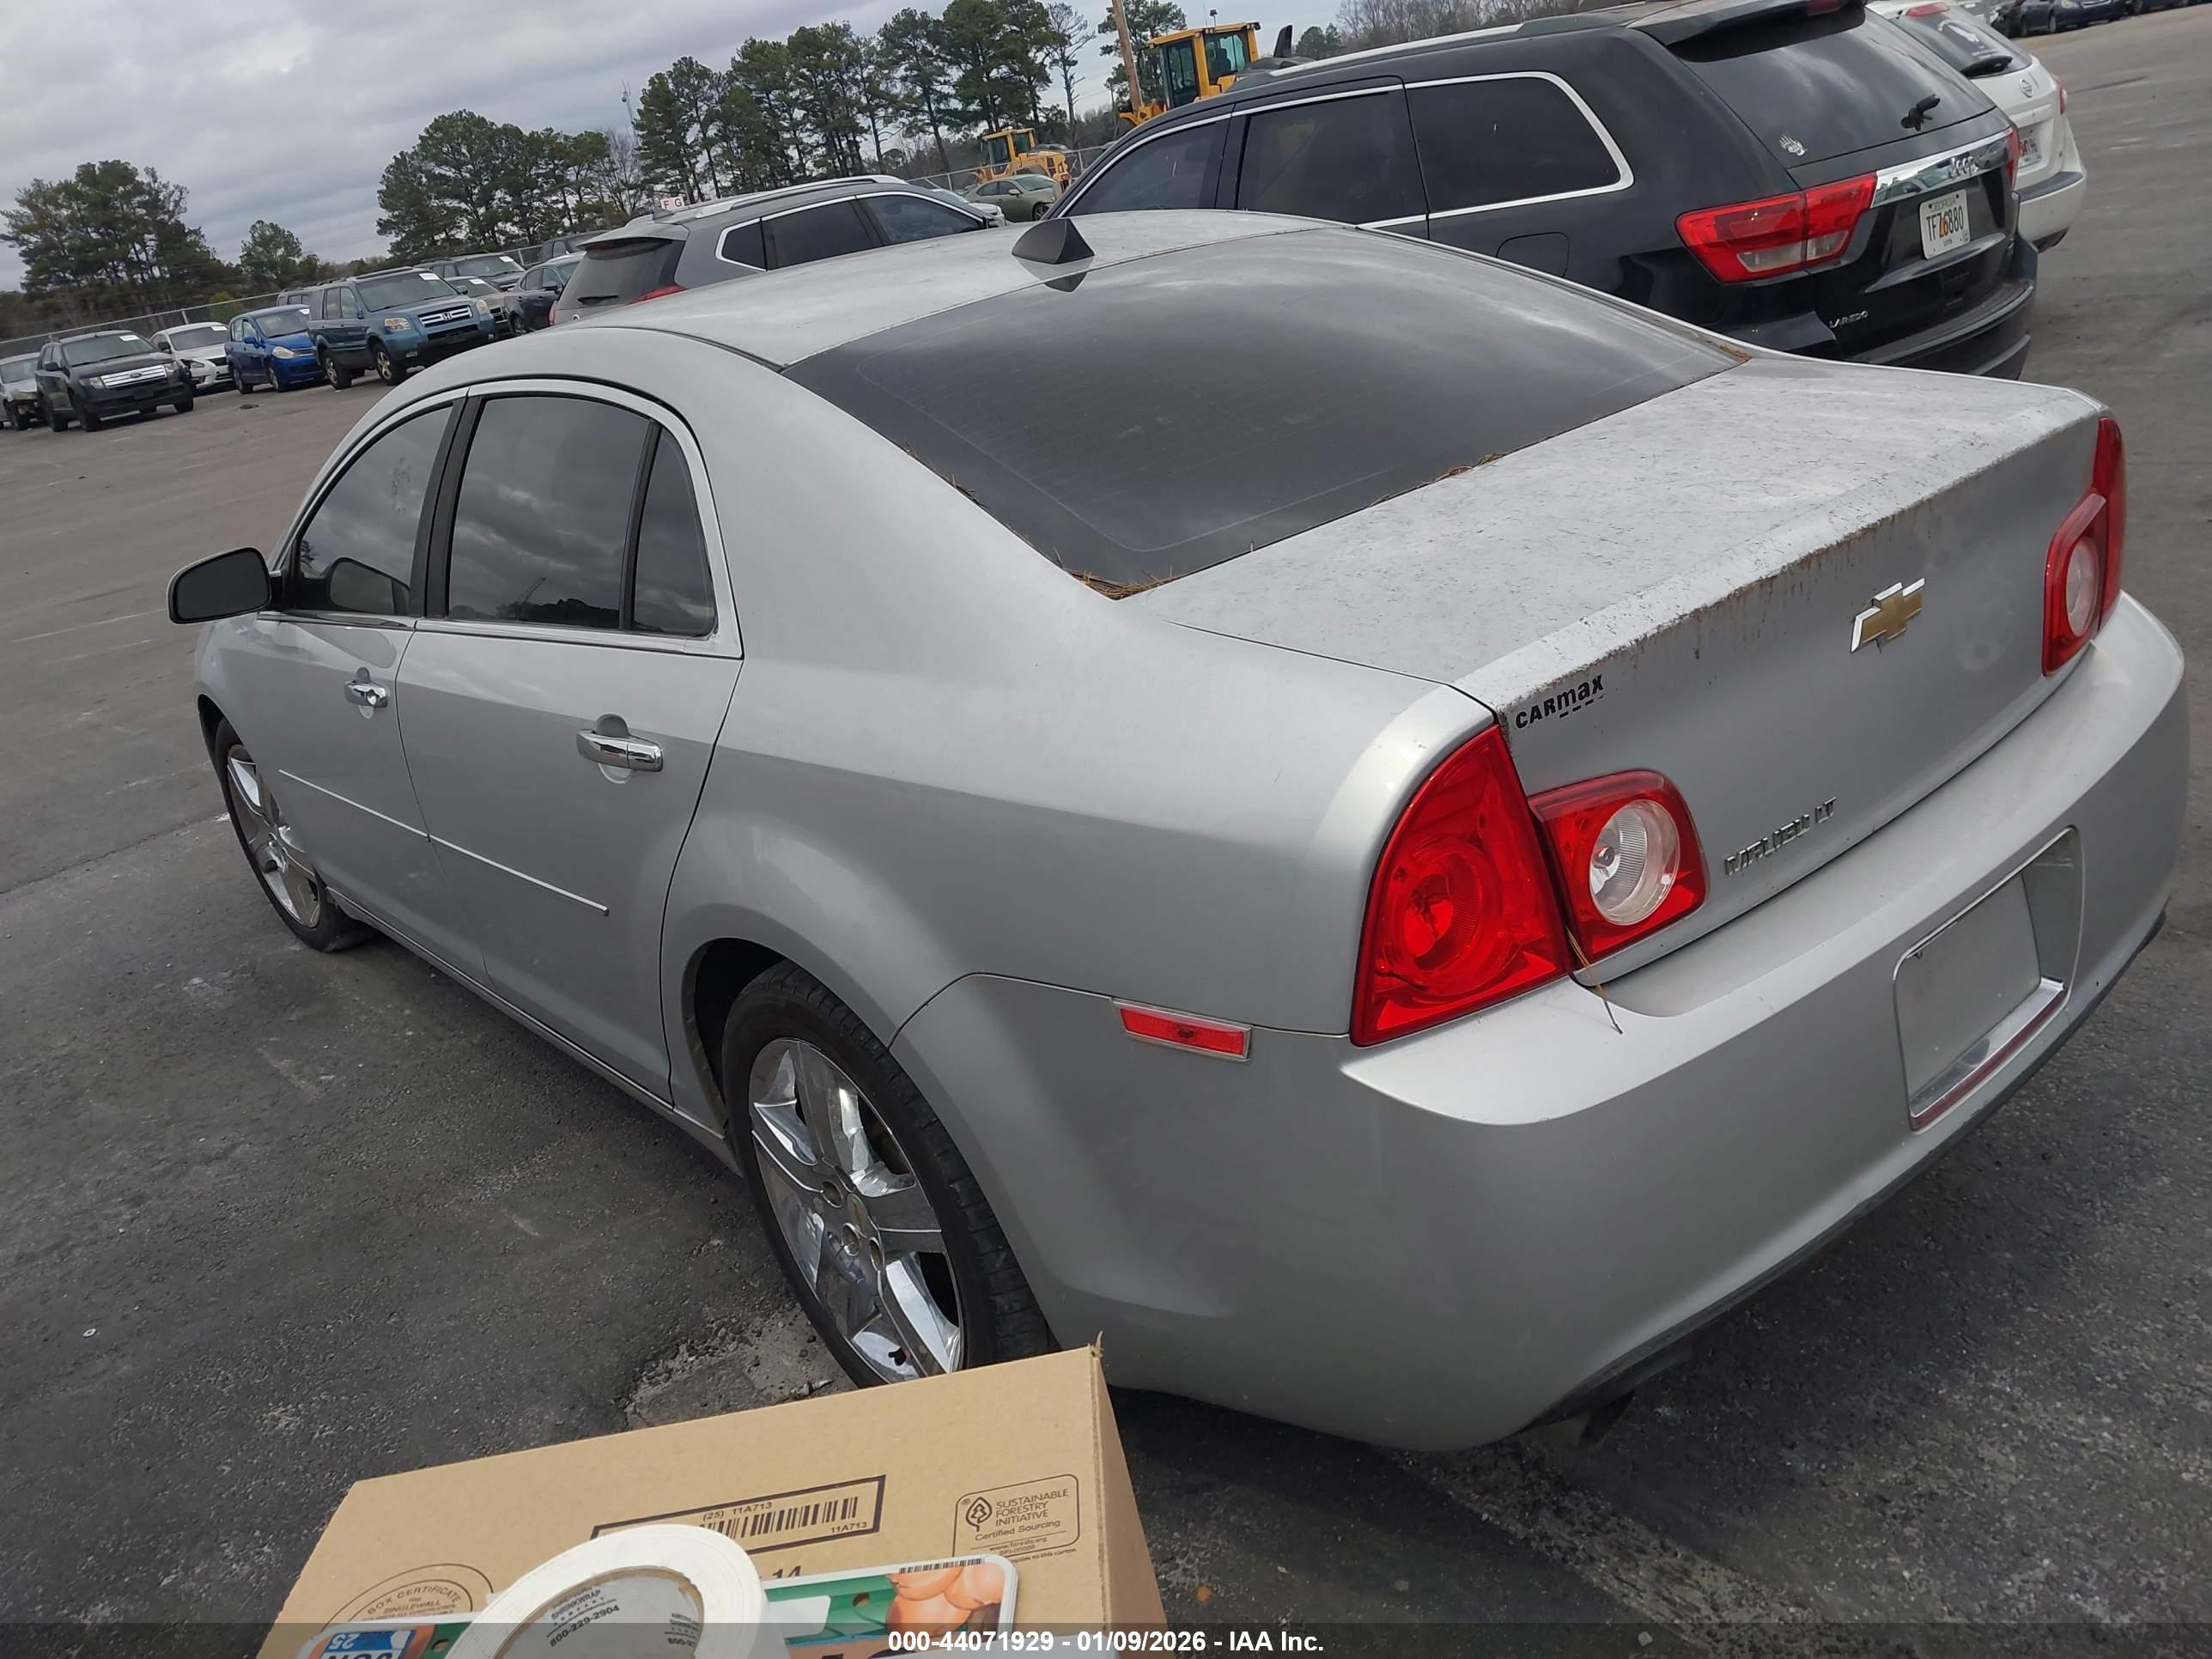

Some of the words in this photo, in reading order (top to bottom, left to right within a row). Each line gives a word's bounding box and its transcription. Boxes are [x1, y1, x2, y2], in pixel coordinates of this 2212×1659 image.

[663, 200, 670, 210] F
[674, 198, 683, 207] G
[1926, 205, 1964, 242] TFZ6880
[1829, 310, 1869, 328] LAREDO
[1724, 814, 1810, 876] MALIBU
[1814, 796, 1837, 823] LT
[996, 1488, 1068, 1509] SUSTAINABLE
[702, 1510, 724, 1522] (25)
[732, 1502, 772, 1516] 11A713
[996, 1500, 1048, 1518] FORESTRY
[996, 1510, 1048, 1527] INITIATIVE
[830, 1522, 867, 1534] 11A713
[975, 1527, 1015, 1541] Certified
[1018, 1520, 1060, 1533] Sourcing
[368, 1597, 392, 1614] BOX
[397, 1585, 461, 1603] CERTIFICATE
[550, 1604, 619, 1647] 800-229-2904
[329, 1632, 362, 1650] 25
